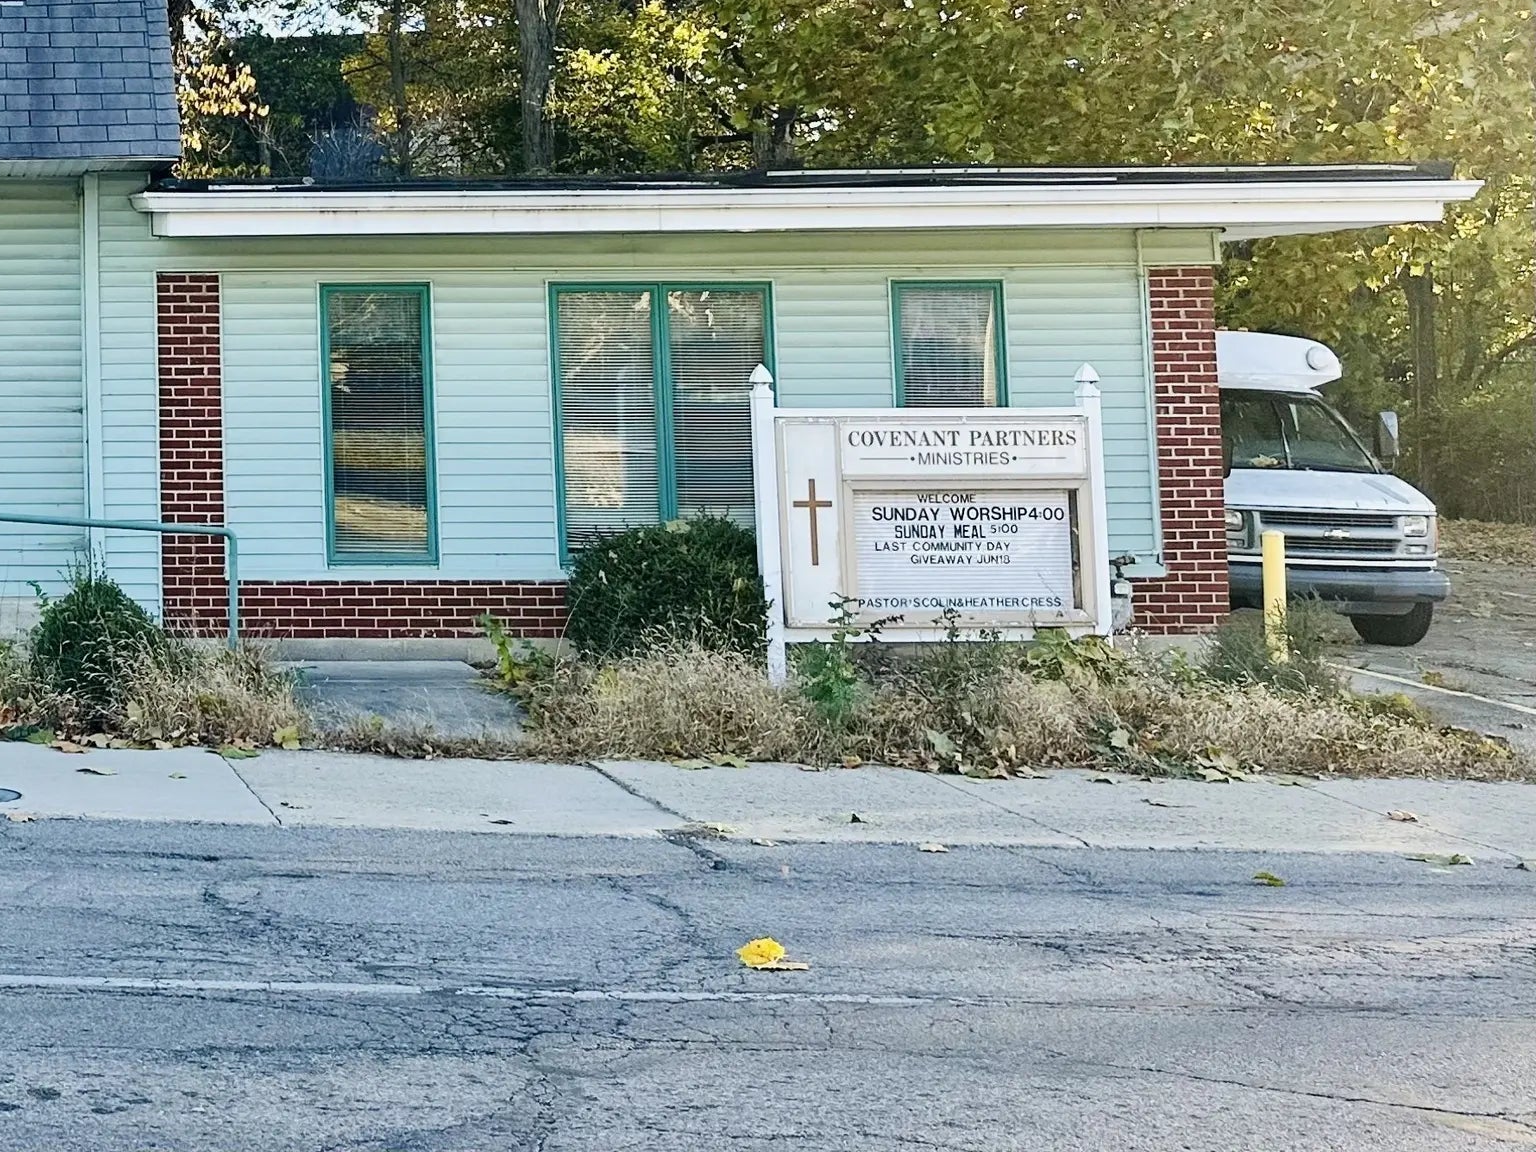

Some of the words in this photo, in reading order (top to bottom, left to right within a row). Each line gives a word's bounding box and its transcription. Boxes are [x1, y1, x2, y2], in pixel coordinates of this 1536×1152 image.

[848, 430, 960, 446] COVENANT
[970, 429, 1077, 446] PARTNERS
[918, 452, 1010, 465] MINISTRIES
[917, 493, 977, 503] WELCOME
[872, 507, 939, 521] SUNDAY
[895, 525, 945, 539] SUNDAY
[954, 524, 986, 538] MEAL
[990, 524, 1018, 533] 5:00
[875, 542, 906, 551] LAST
[913, 541, 982, 551] COMMUNITY
[987, 542, 1010, 551] DAY
[910, 554, 972, 564] GIVEAWAY
[1021, 596, 1062, 607] CRESS
